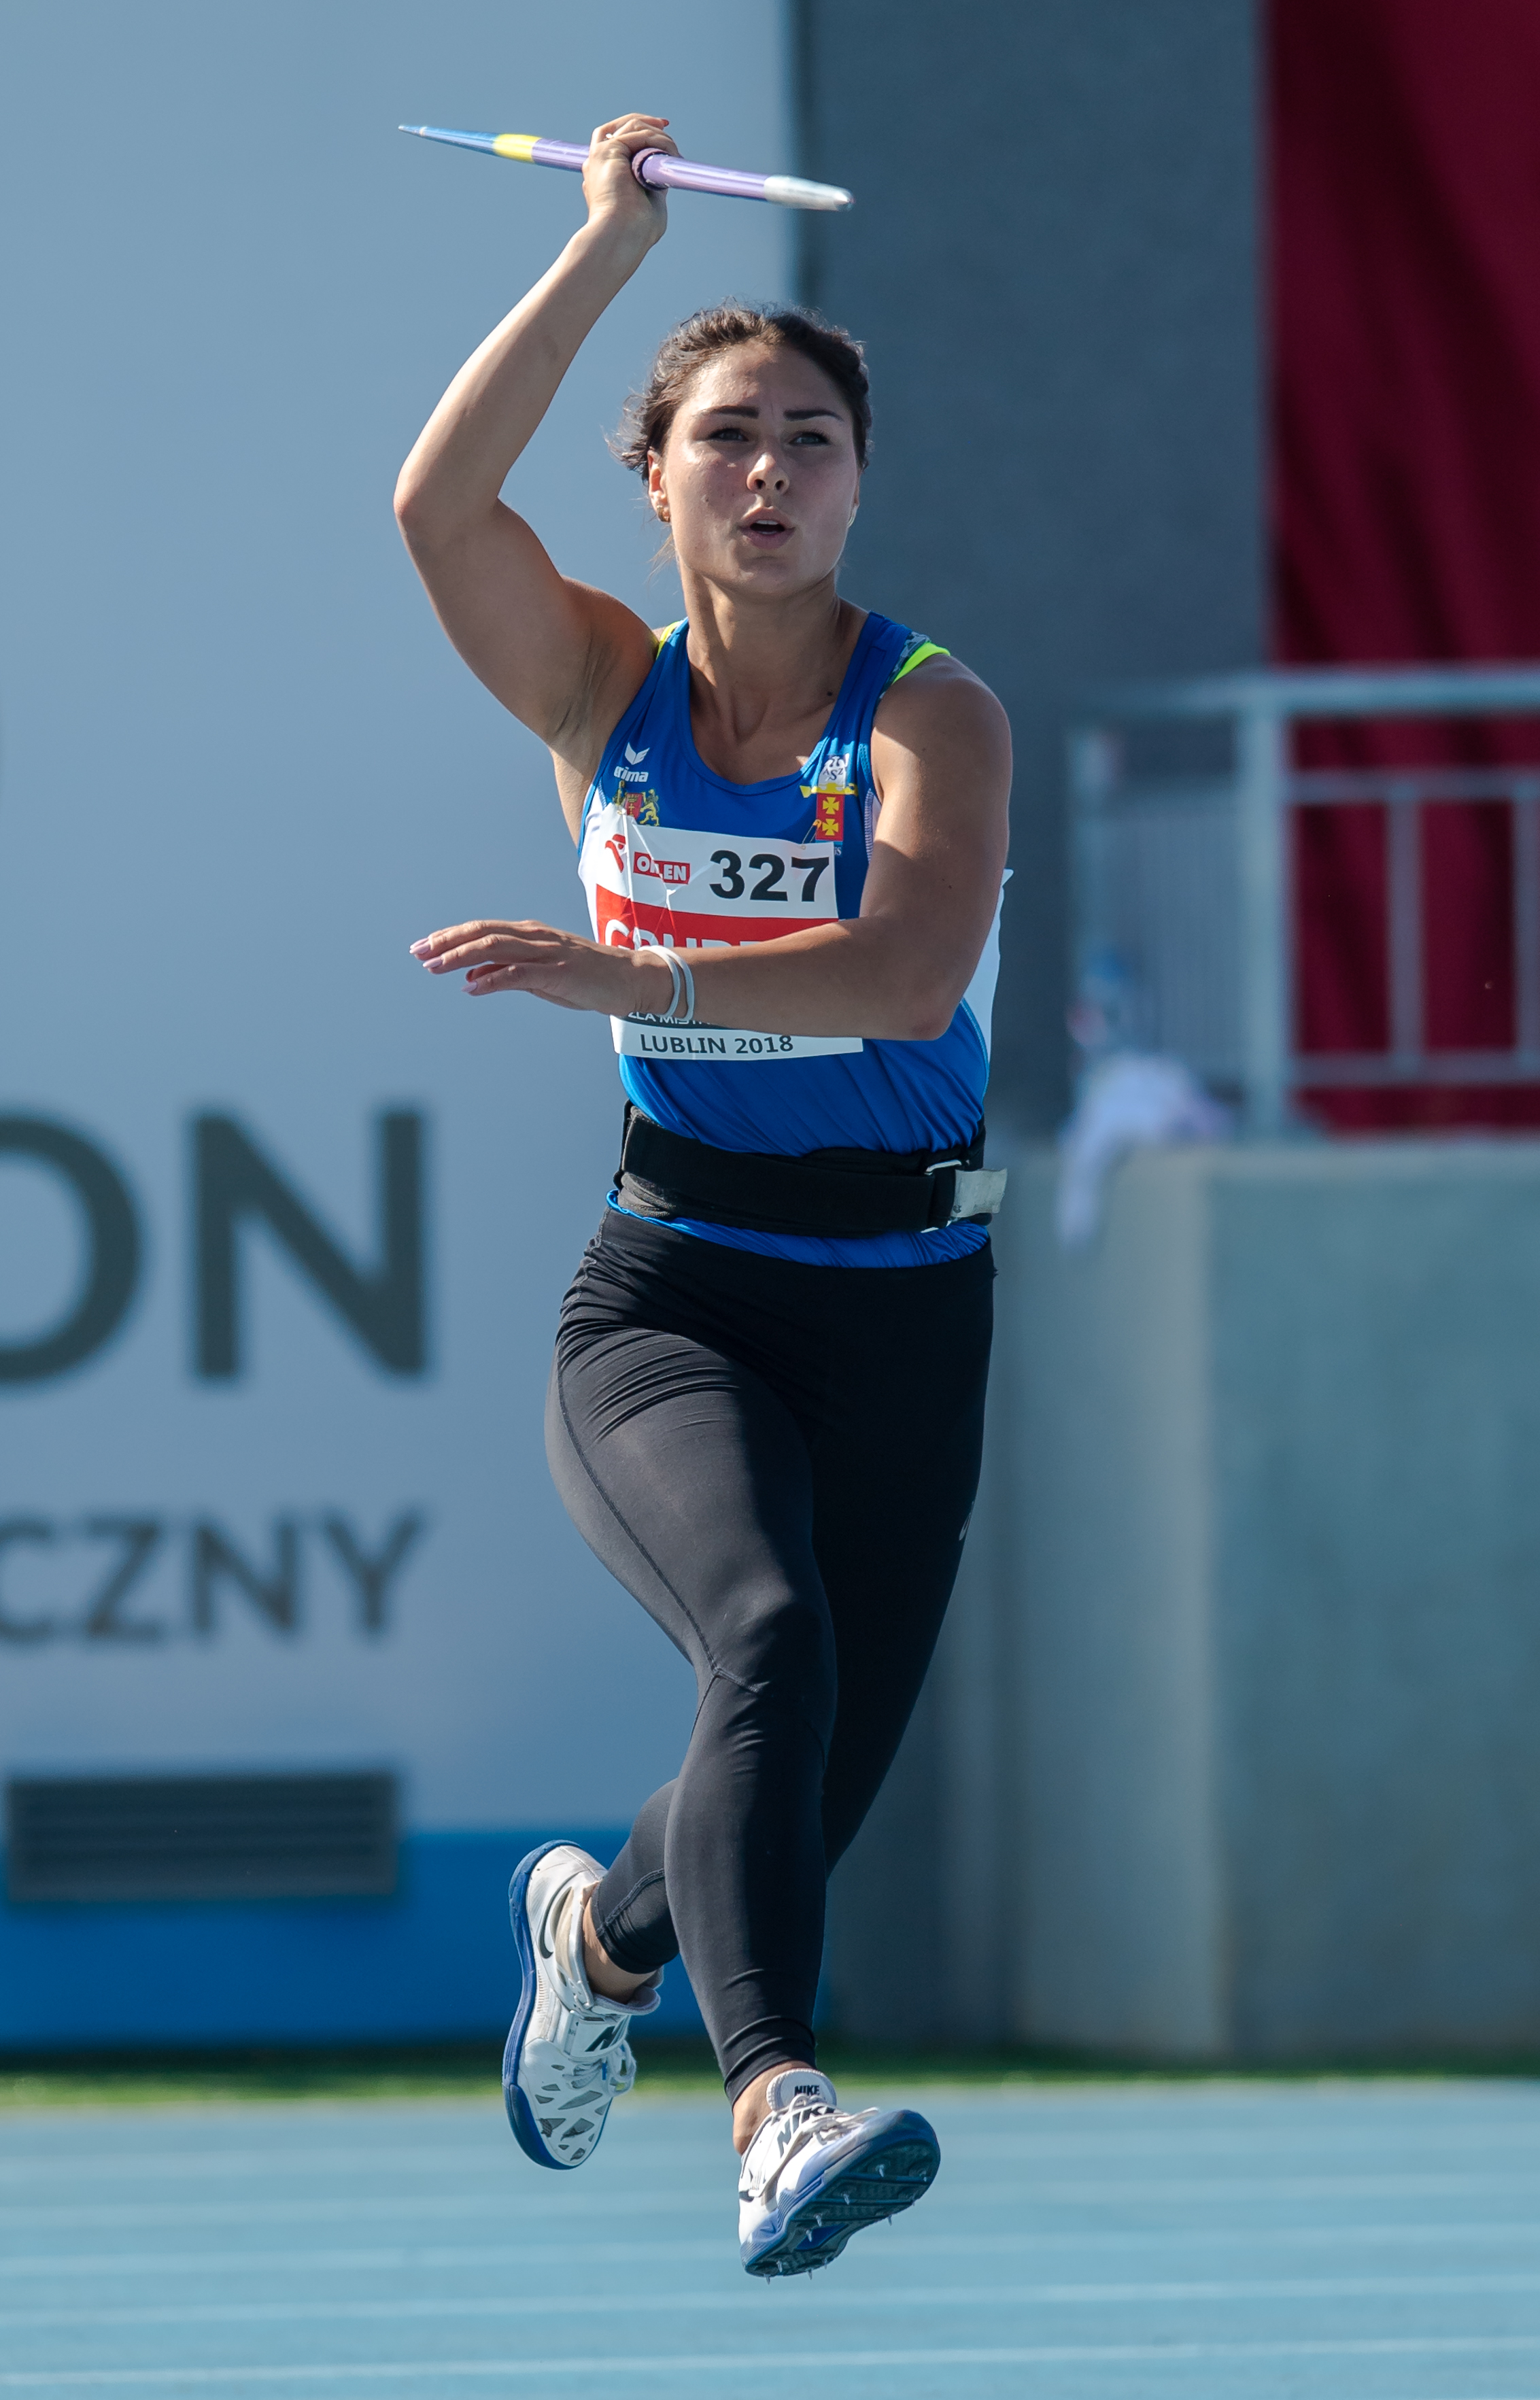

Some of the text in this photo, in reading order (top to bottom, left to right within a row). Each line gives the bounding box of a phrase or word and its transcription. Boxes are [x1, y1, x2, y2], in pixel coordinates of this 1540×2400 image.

[709, 849, 829, 902] 327
[640, 1033, 793, 1054] LUBLIN 2018
[794, 2085, 820, 2096] NIKE
